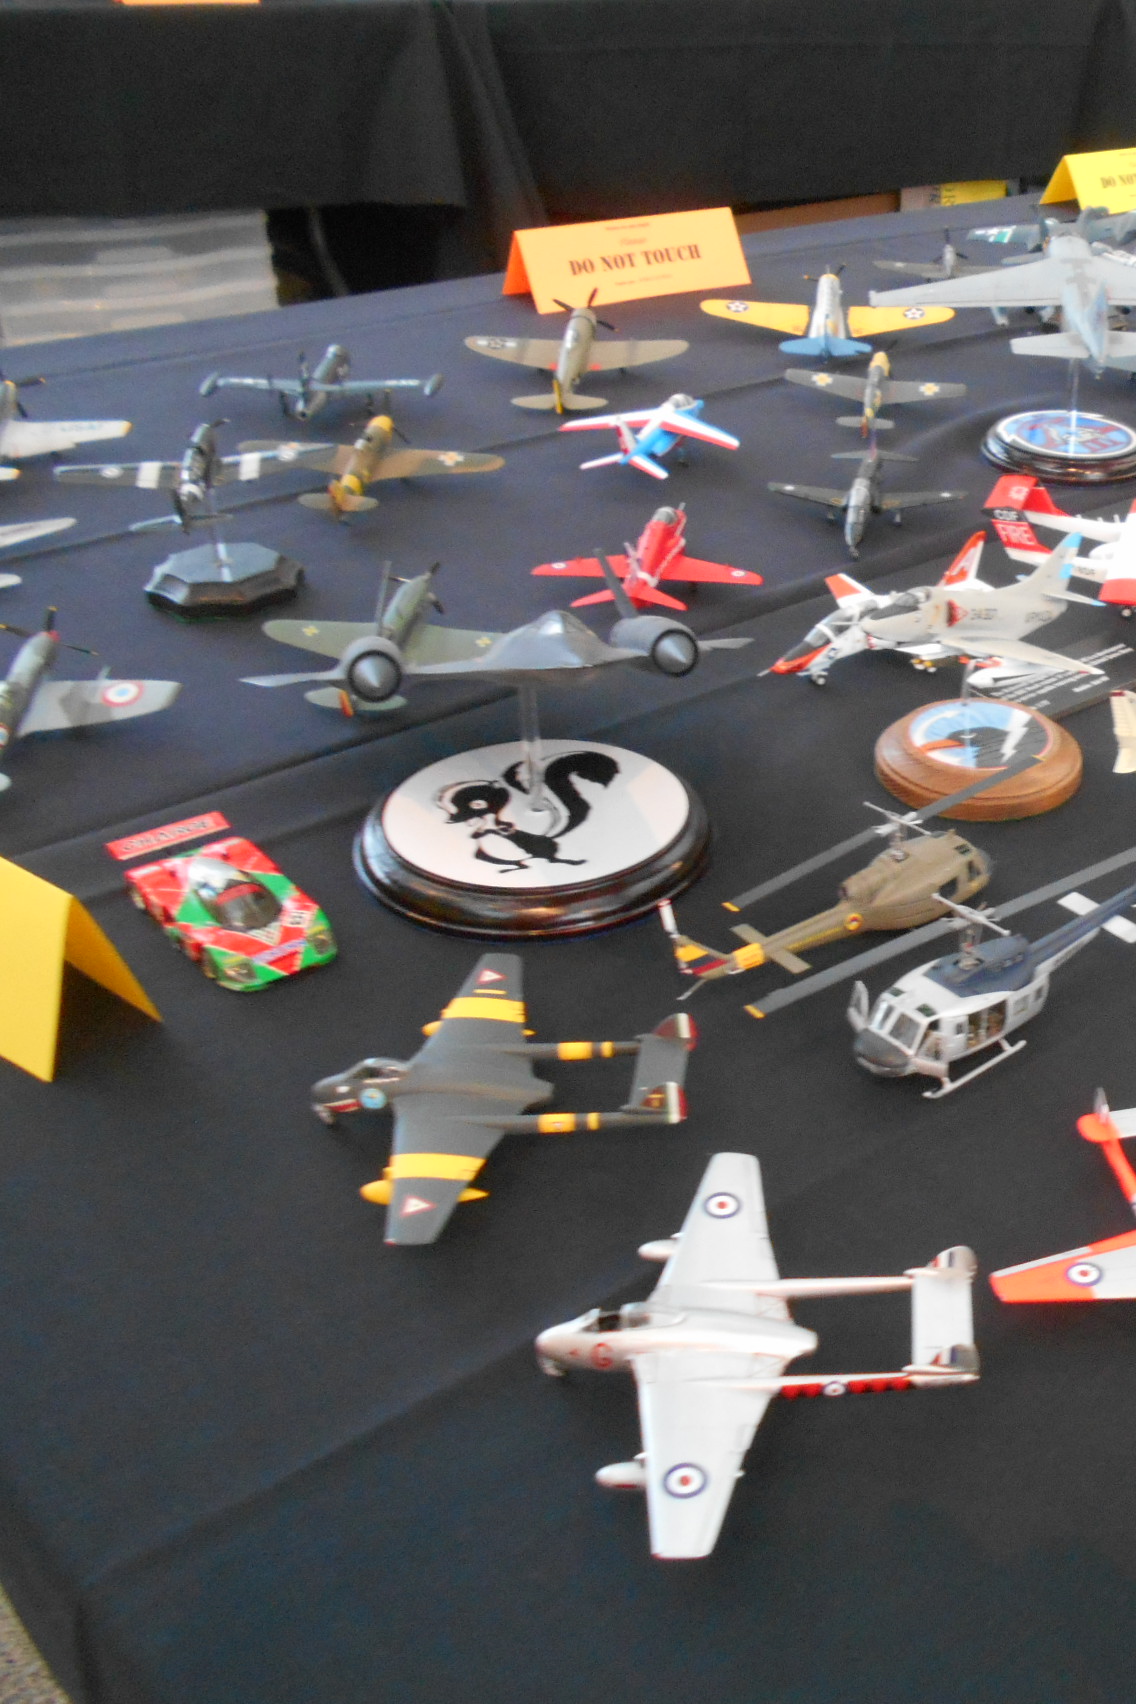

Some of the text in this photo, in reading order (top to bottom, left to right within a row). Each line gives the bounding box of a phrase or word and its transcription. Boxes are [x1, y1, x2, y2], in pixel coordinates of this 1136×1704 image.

[1100, 176, 1117, 189] DO
[568, 243, 702, 276] DO NOT TOUCH
[998, 523, 1036, 545] FIRE
